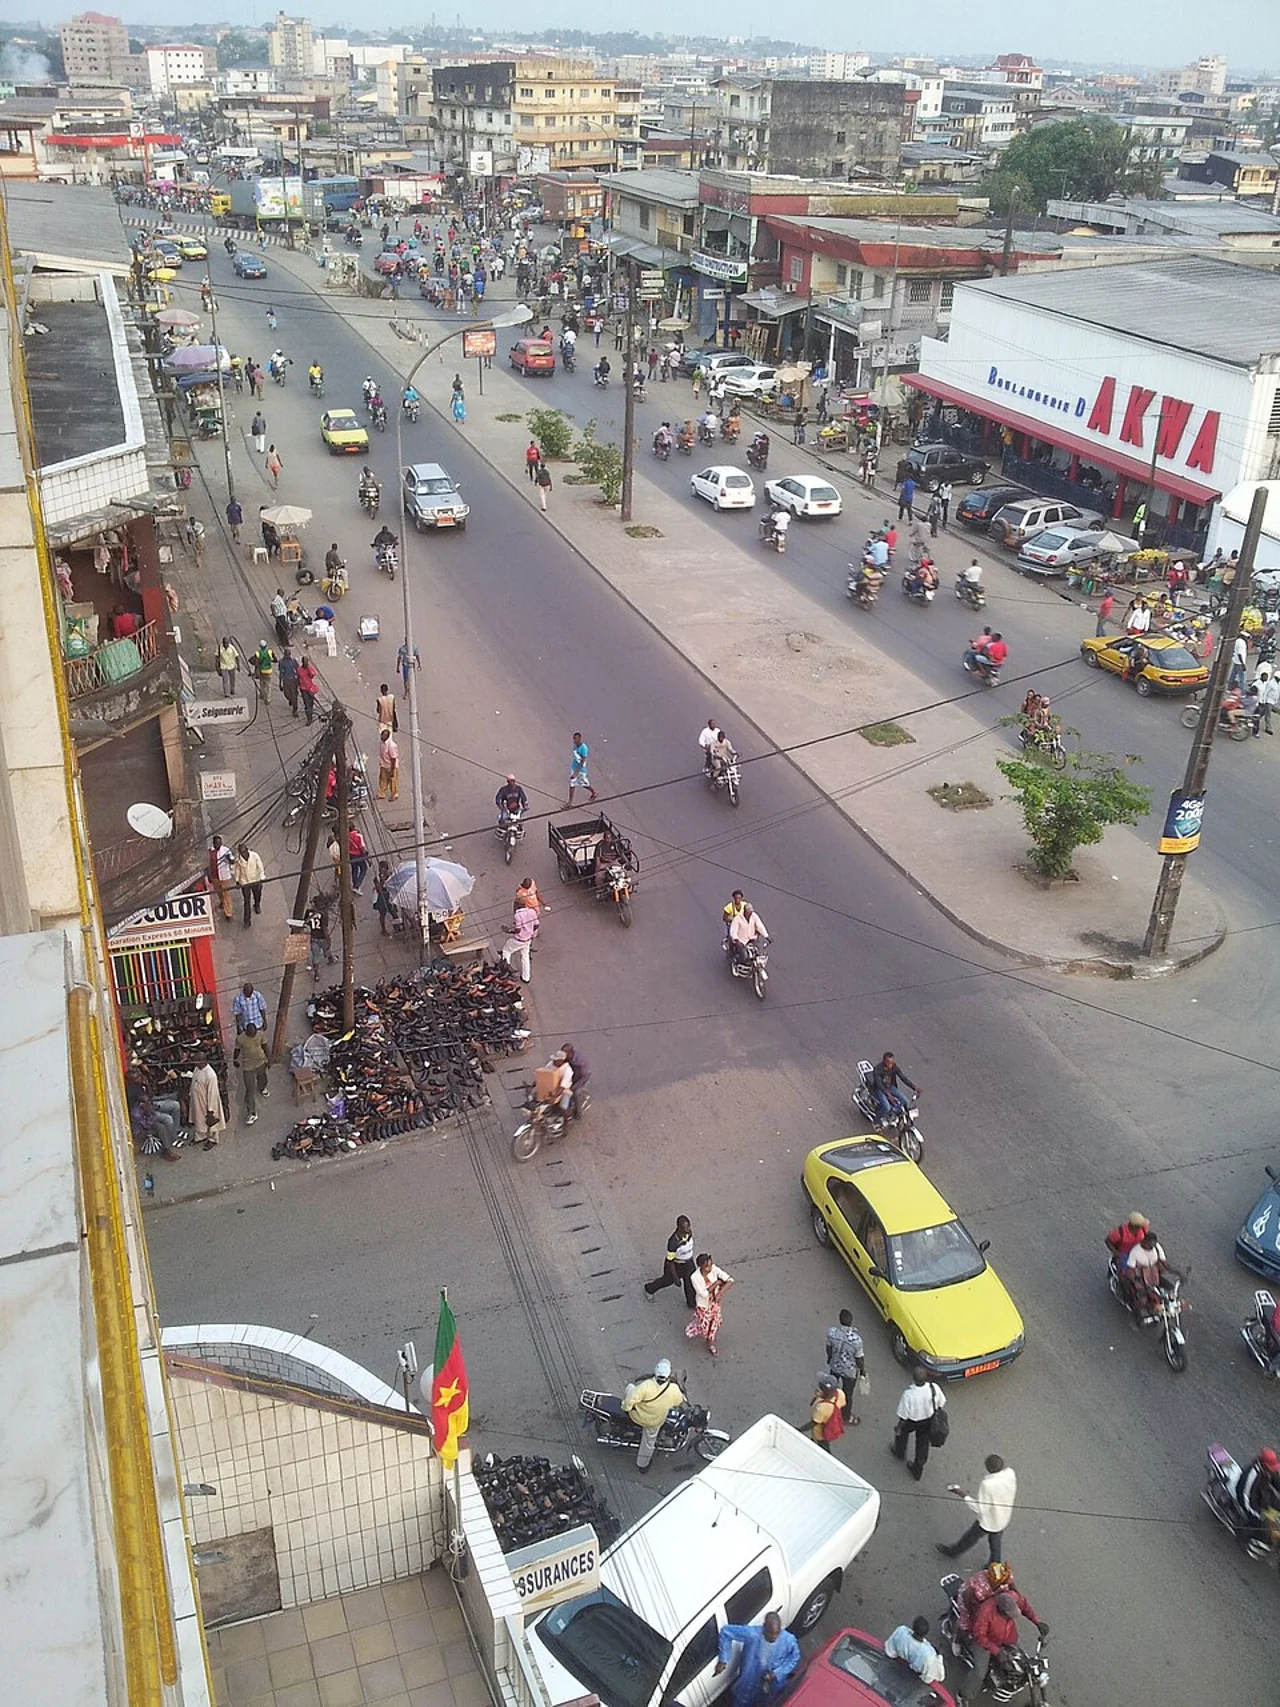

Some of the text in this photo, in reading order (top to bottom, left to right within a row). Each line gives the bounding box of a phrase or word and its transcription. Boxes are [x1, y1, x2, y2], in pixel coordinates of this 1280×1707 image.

[1087, 376, 1221, 474] AKWA
[202, 705, 243, 718] Seigneurie
[311, 918, 321, 929] 12
[142, 930, 173, 943] Express
[184, 925, 212, 936] Minutes
[513, 1550, 594, 1597] SSURANCES
